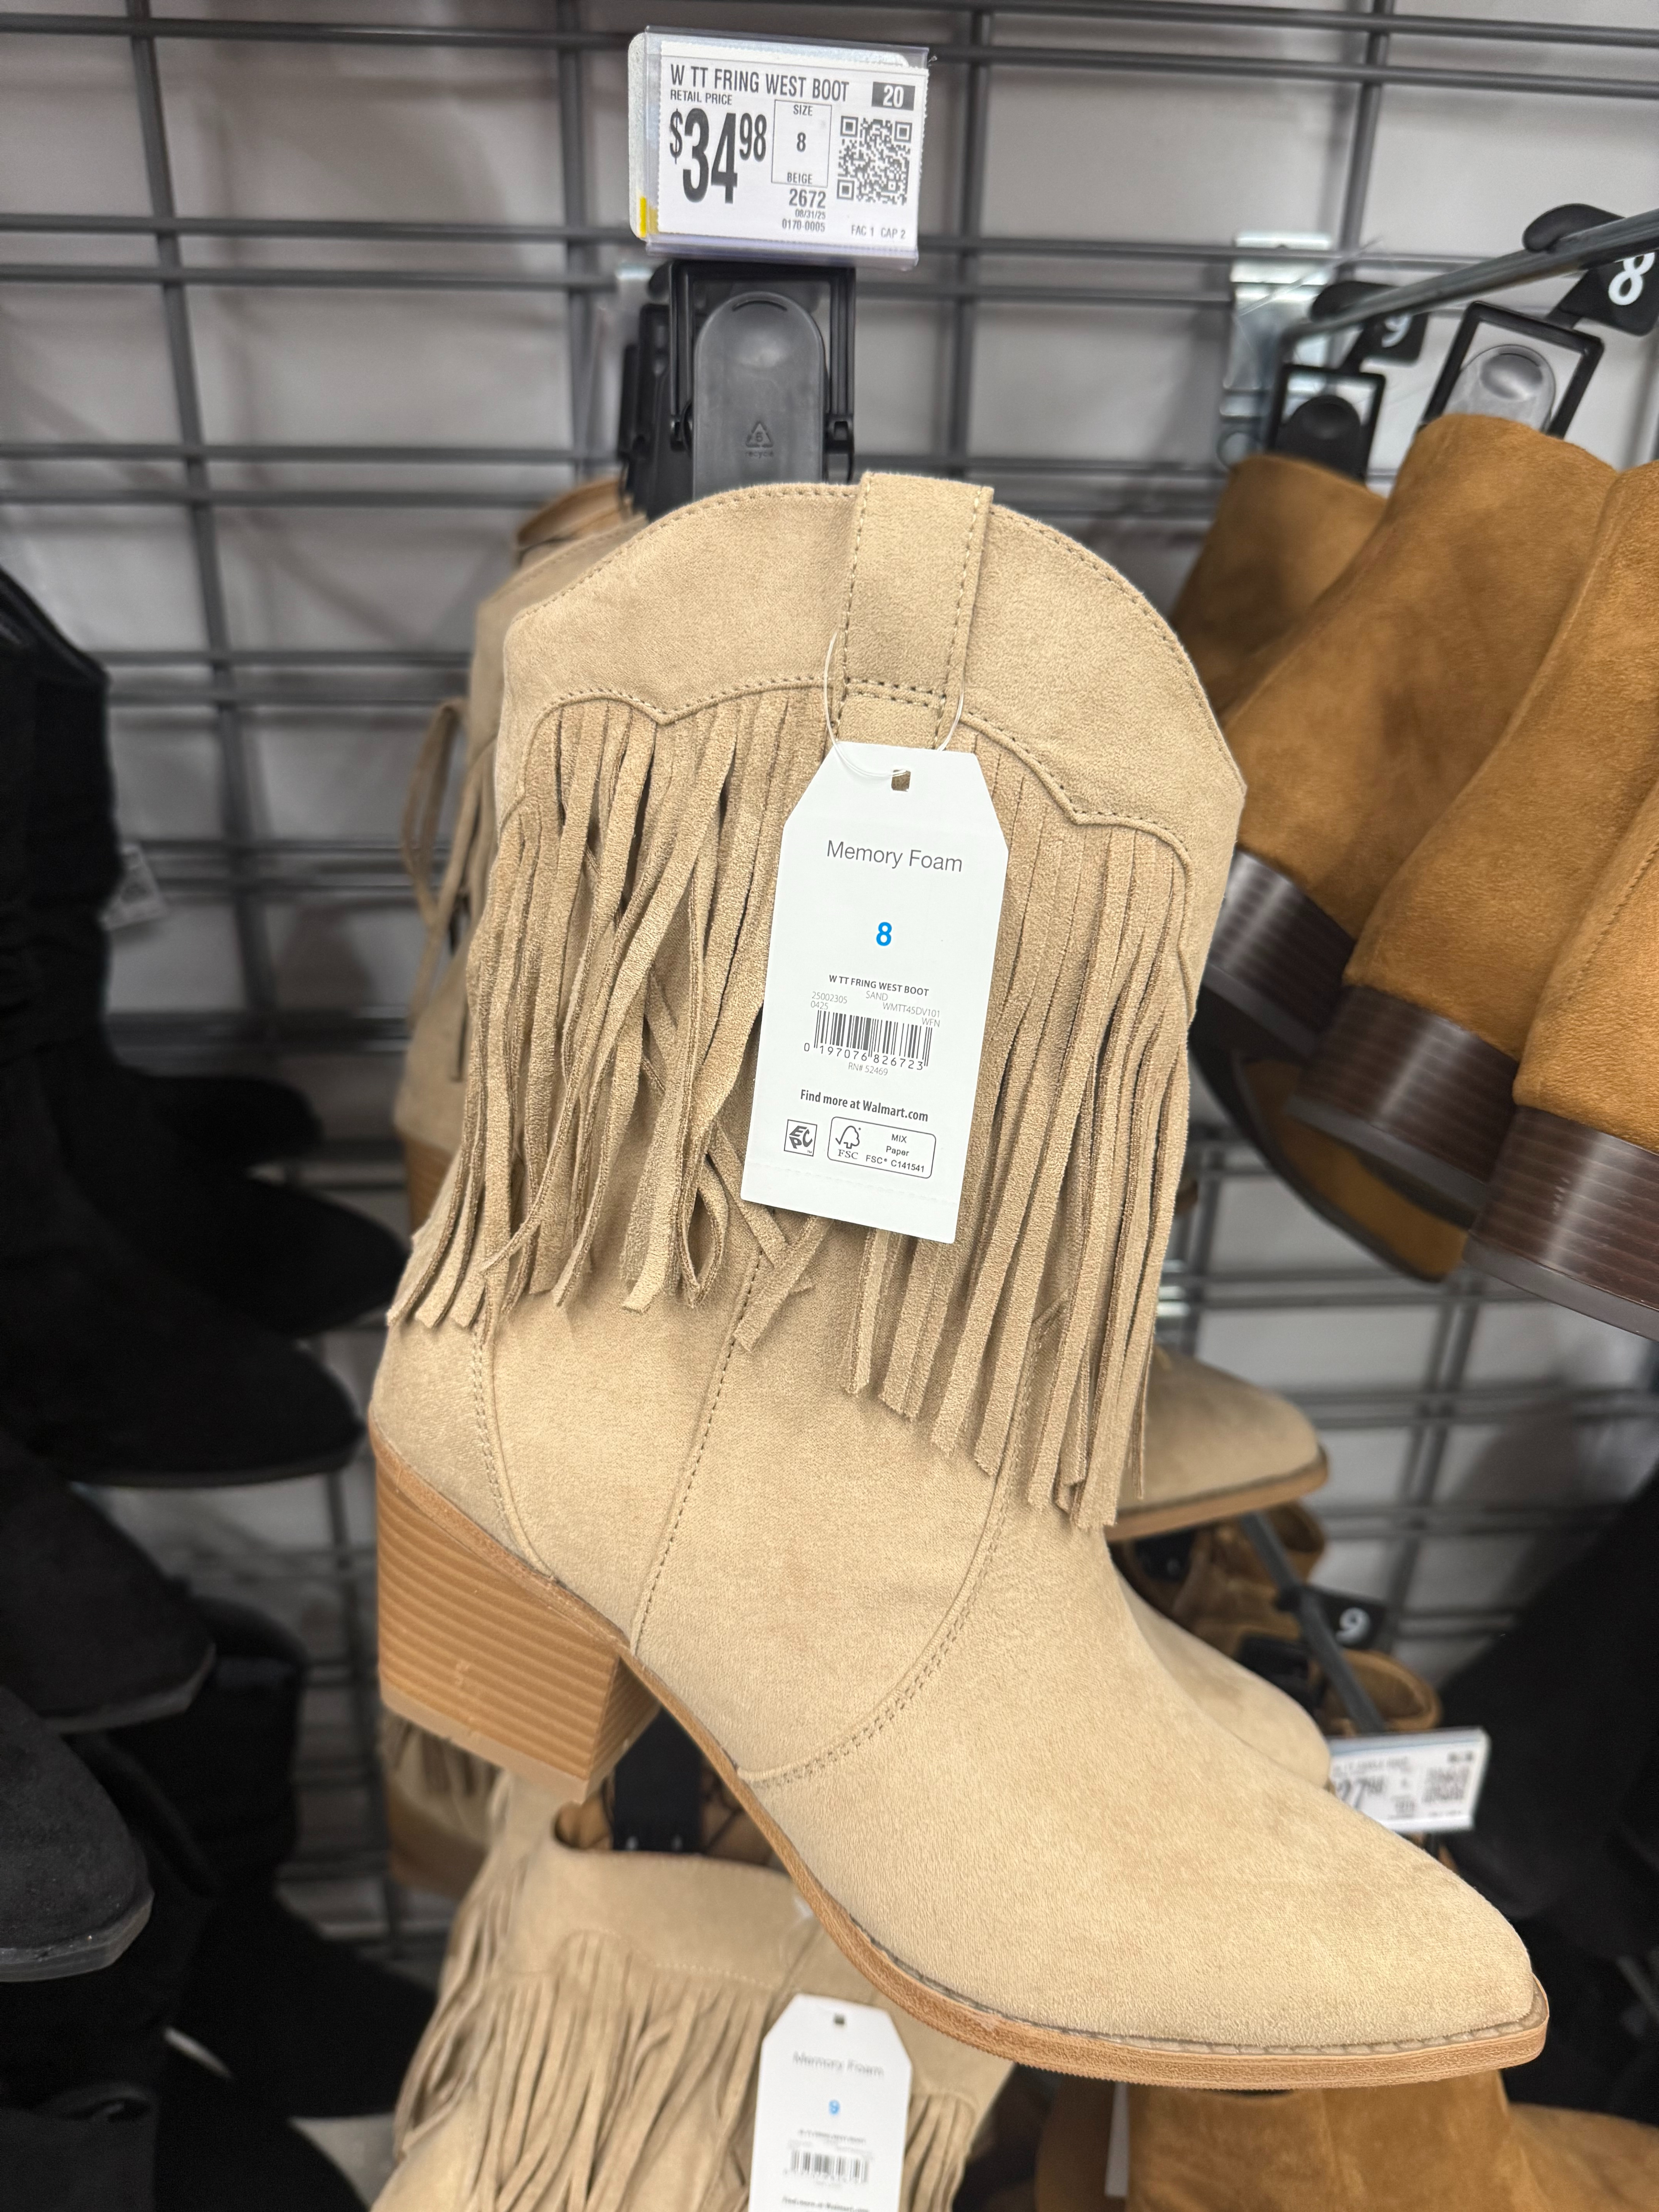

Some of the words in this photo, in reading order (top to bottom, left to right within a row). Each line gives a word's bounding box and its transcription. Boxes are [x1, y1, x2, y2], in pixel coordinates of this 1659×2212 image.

[671, 64, 684, 86] W
[691, 66, 708, 88] TT
[714, 69, 759, 93] FRING
[766, 73, 806, 98] WEST
[813, 78, 849, 101] BOOT
[670, 89, 702, 103] RETAIL
[706, 93, 732, 105] PRICE
[883, 85, 904, 108] 20
[793, 105, 812, 116] SIZE
[797, 132, 806, 152] 8
[787, 172, 812, 184] BEIGE
[789, 188, 826, 209] 2672
[795, 208, 826, 220] 08/31/25
[851, 225, 866, 236] FAC
[871, 227, 874, 237] 1
[881, 227, 898, 239] CAP
[901, 229, 906, 239] 2
[1608, 252, 1655, 305] 8
[827, 840, 903, 869] Memory
[909, 849, 962, 872] Foam
[876, 922, 892, 946] 8
[839, 976, 849, 984] TT
[851, 978, 876, 988] FRING
[879, 982, 903, 992] WEST
[904, 986, 929, 996] BOOT
[812, 991, 847, 1004] 25002305
[866, 991, 888, 1001] SAND
[811, 1000, 828, 1010] 0425
[883, 1002, 940, 1018] WMTT45DV101
[922, 1017, 940, 1027] WFN
[804, 1043, 810, 1051] 0
[848, 1062, 863, 1071] RN#
[865, 1065, 888, 1076] 52469
[800, 1089, 821, 1103] Find
[823, 1096, 848, 1108] more
[850, 1100, 860, 1109] at
[863, 1100, 928, 1122] Walmart.com
[891, 1133, 907, 1143] MIX
[838, 1149, 858, 1159] FSC
[886, 1146, 909, 1156] Paper
[891, 1159, 924, 1173] C141541
[1337, 1607, 1370, 1643] 9
